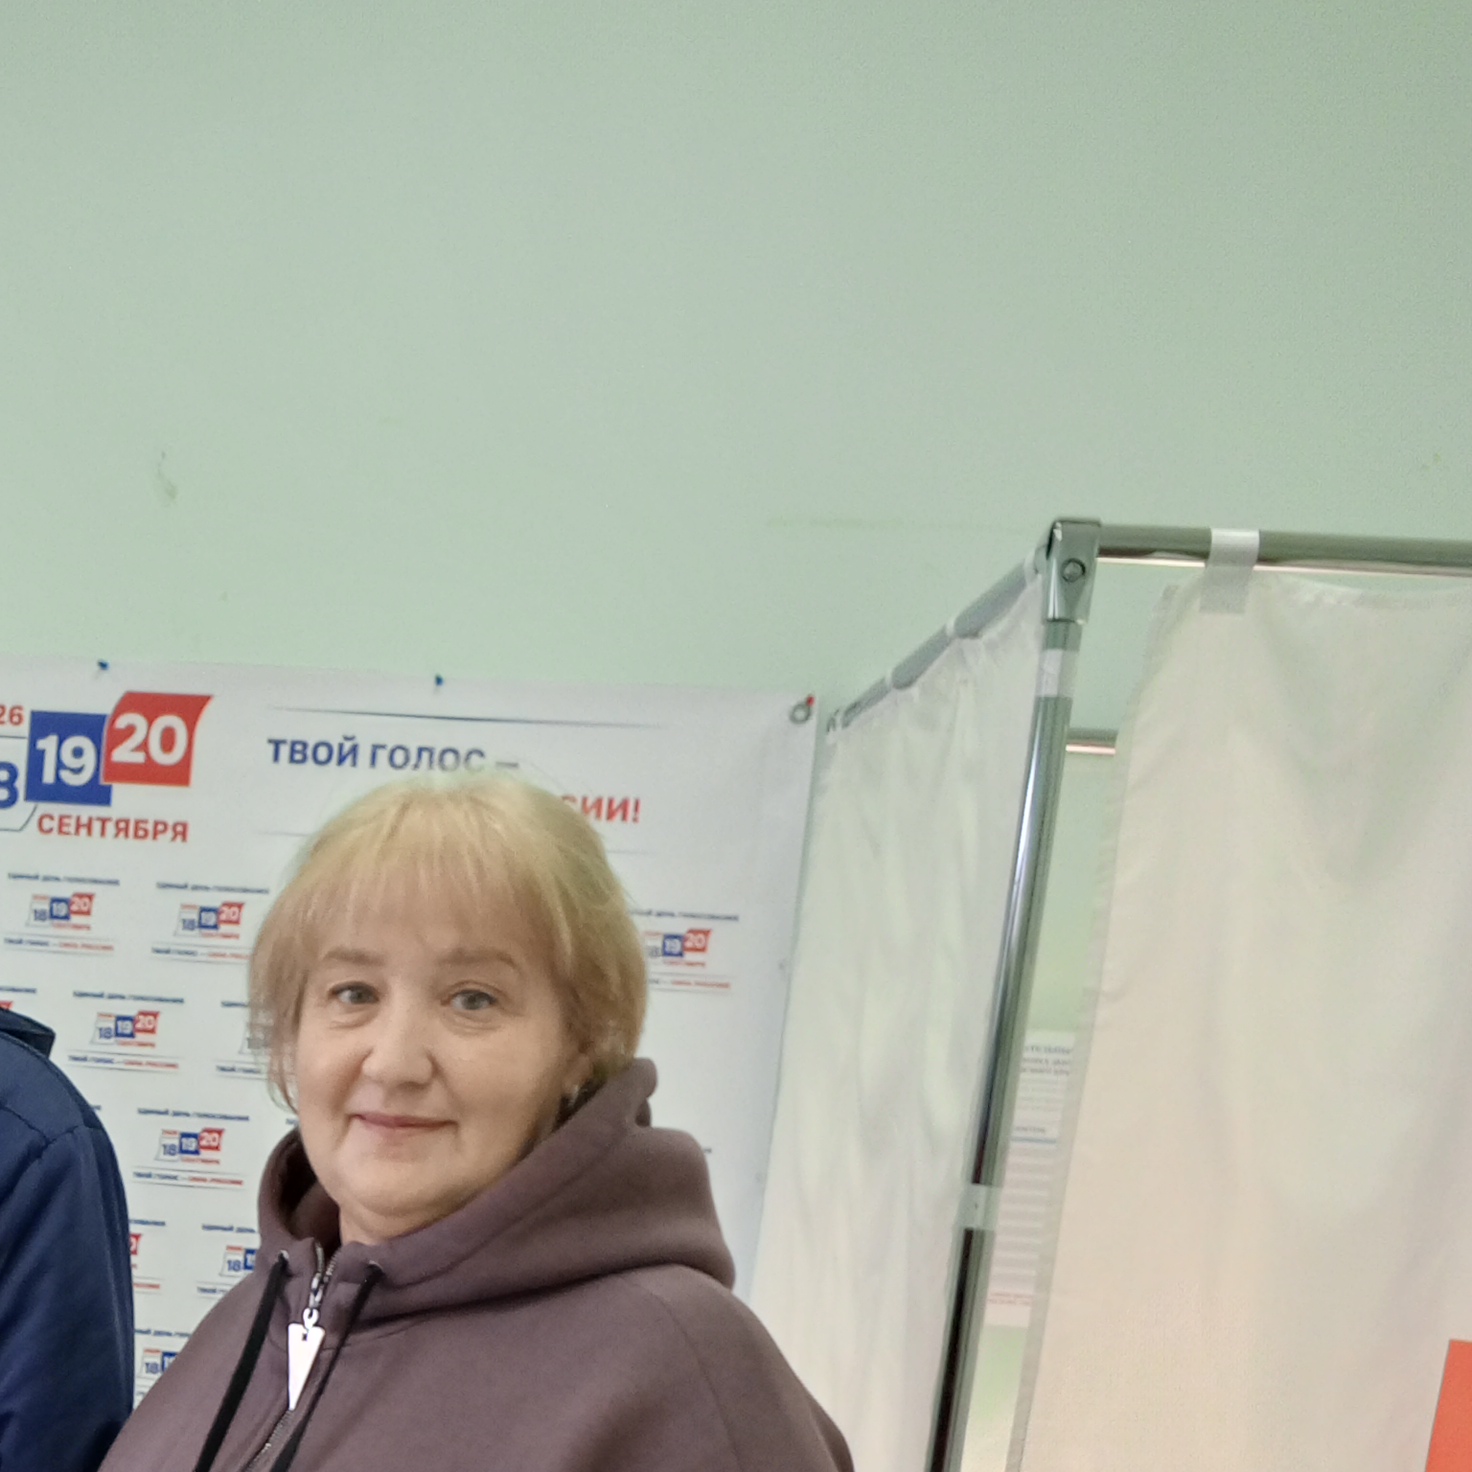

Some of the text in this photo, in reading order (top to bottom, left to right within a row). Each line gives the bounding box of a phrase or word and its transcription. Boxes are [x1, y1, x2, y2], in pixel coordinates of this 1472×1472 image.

[36, 734, 97, 787] 19
[111, 712, 188, 766] 20
[267, 735, 358, 768] ТВОЙ
[369, 743, 485, 773] ГОЛОС
[37, 813, 188, 843] СЕНТЯБРЯ
[71, 897, 91, 912] 20
[219, 907, 240, 921] 20
[686, 934, 706, 948] 20
[135, 1016, 155, 1030] 20
[200, 1132, 220, 1147] 20
